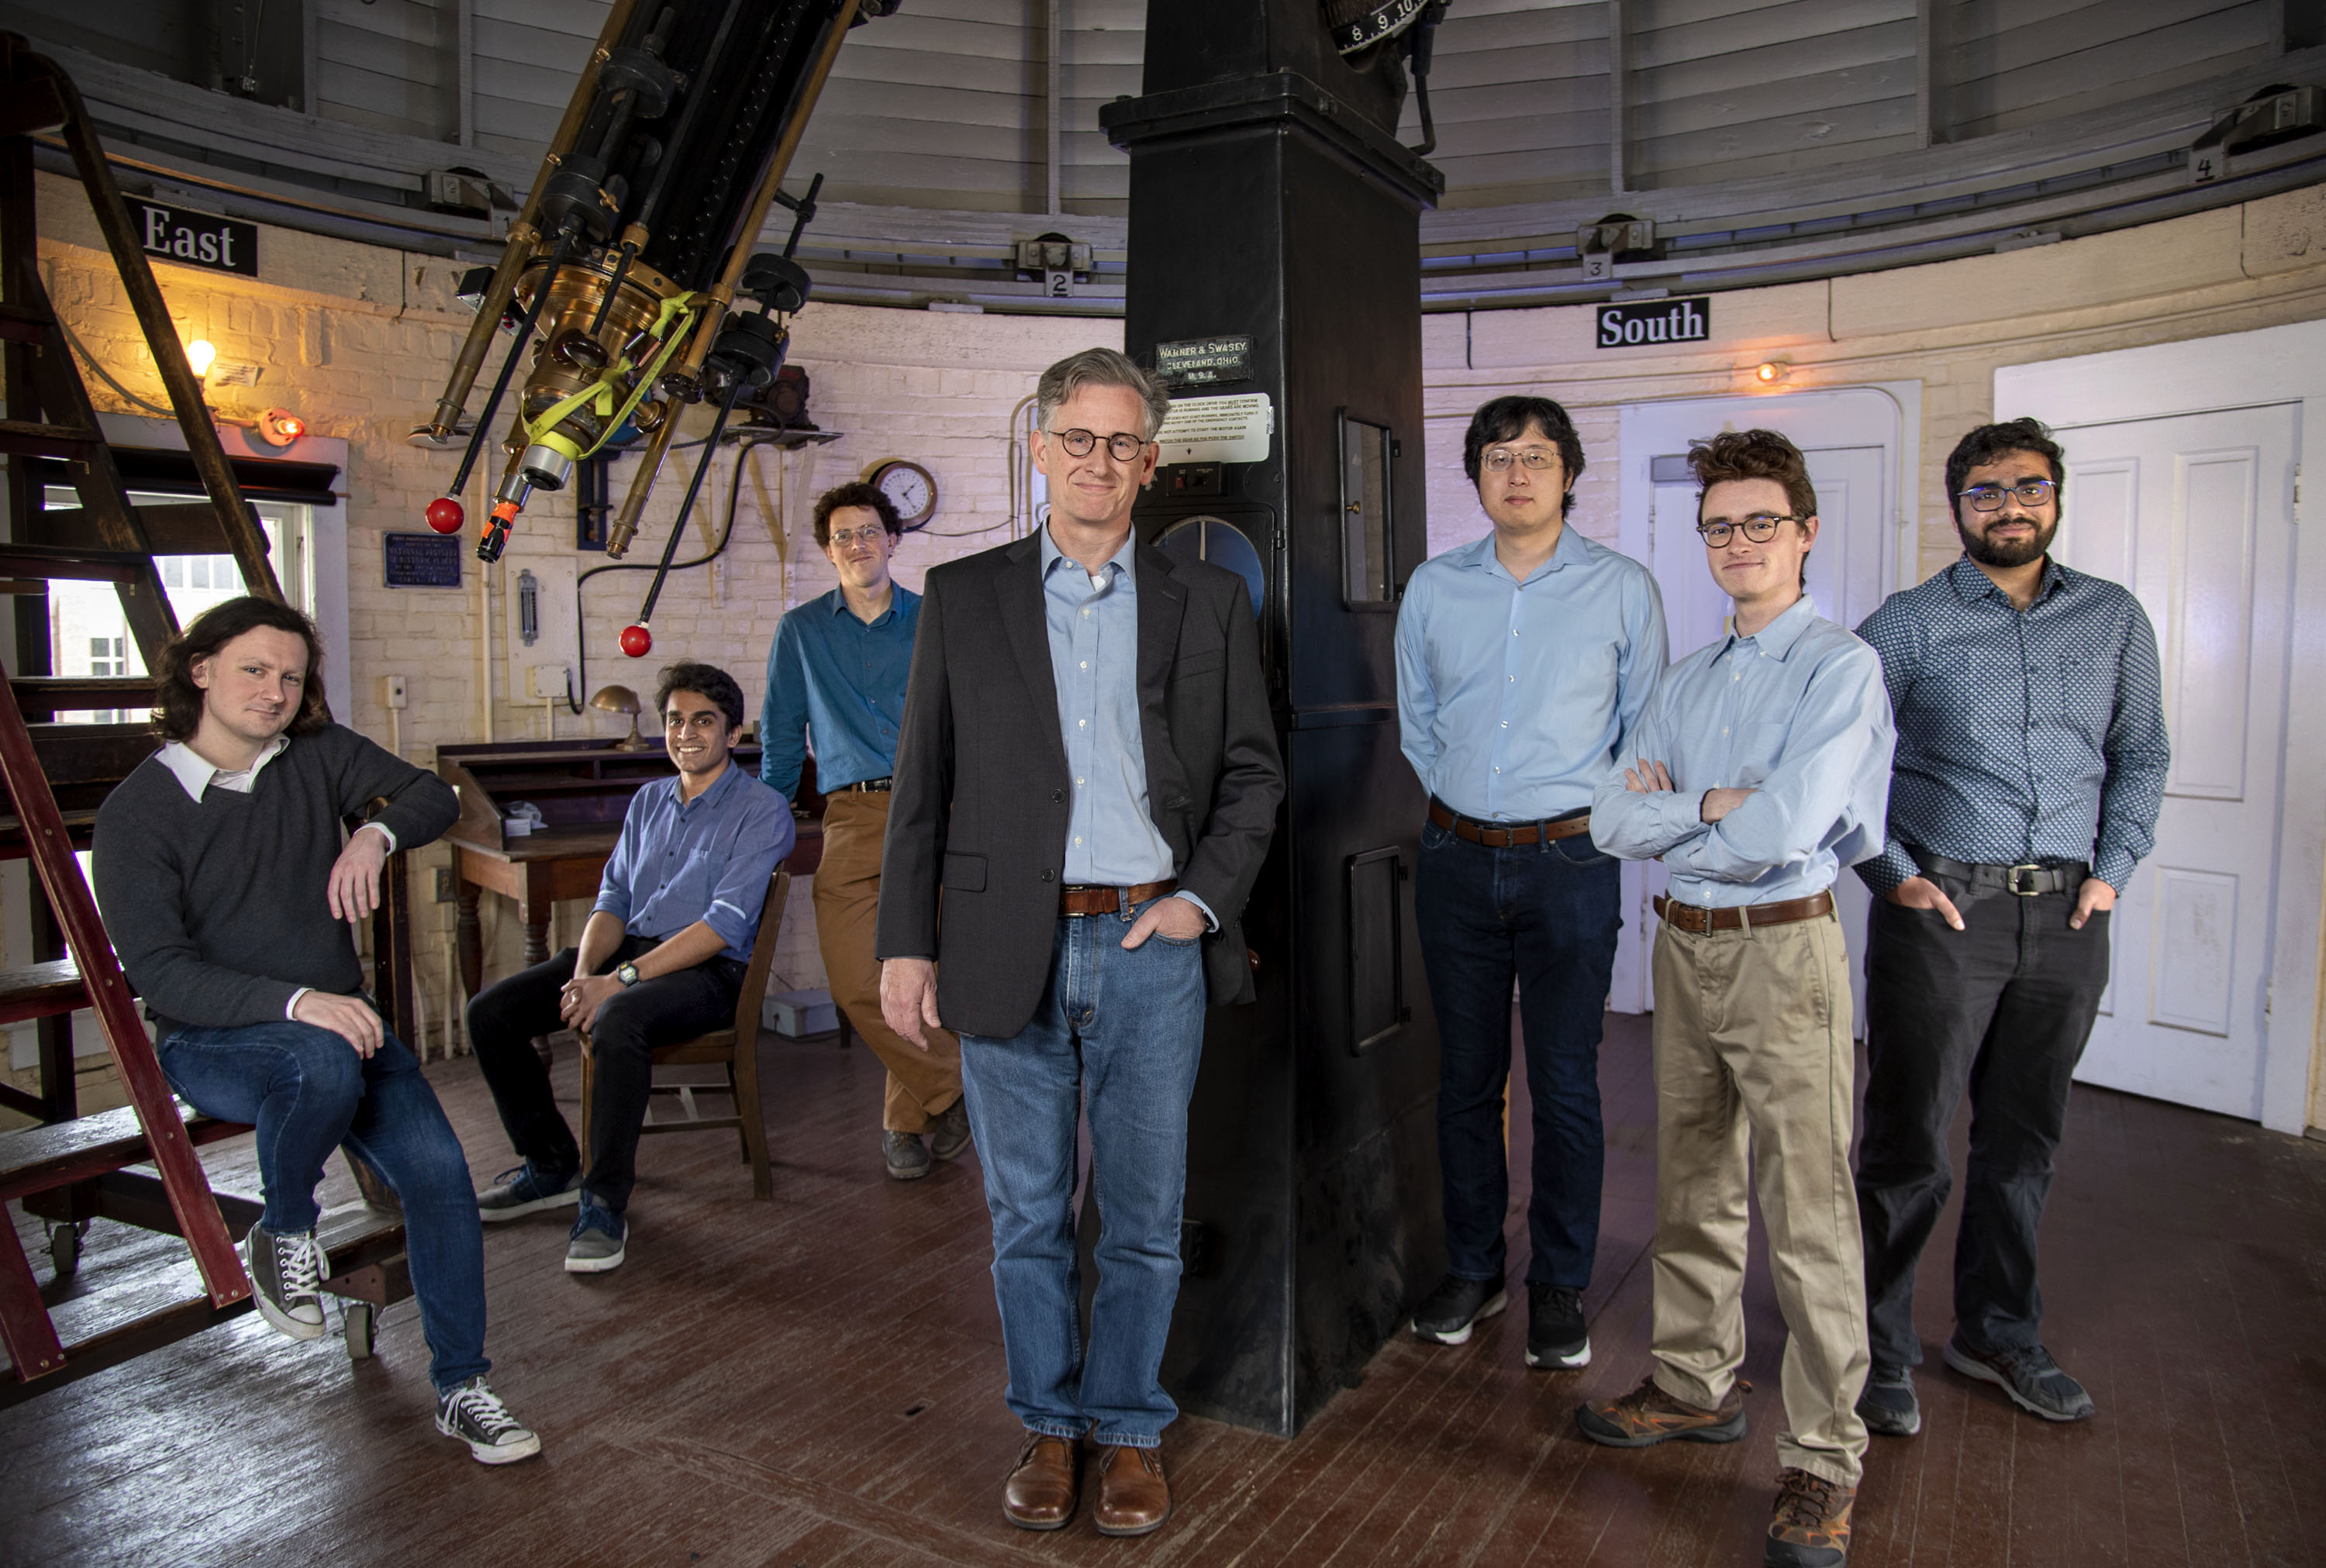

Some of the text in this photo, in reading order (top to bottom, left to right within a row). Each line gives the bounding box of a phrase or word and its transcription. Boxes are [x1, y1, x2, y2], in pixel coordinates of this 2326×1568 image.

[2197, 159, 2212, 177] 4
[142, 205, 236, 267] East
[1590, 262, 1602, 276] 3
[1053, 274, 1067, 291] 2
[1601, 302, 1705, 346] South
[1198, 346, 1206, 355] &
